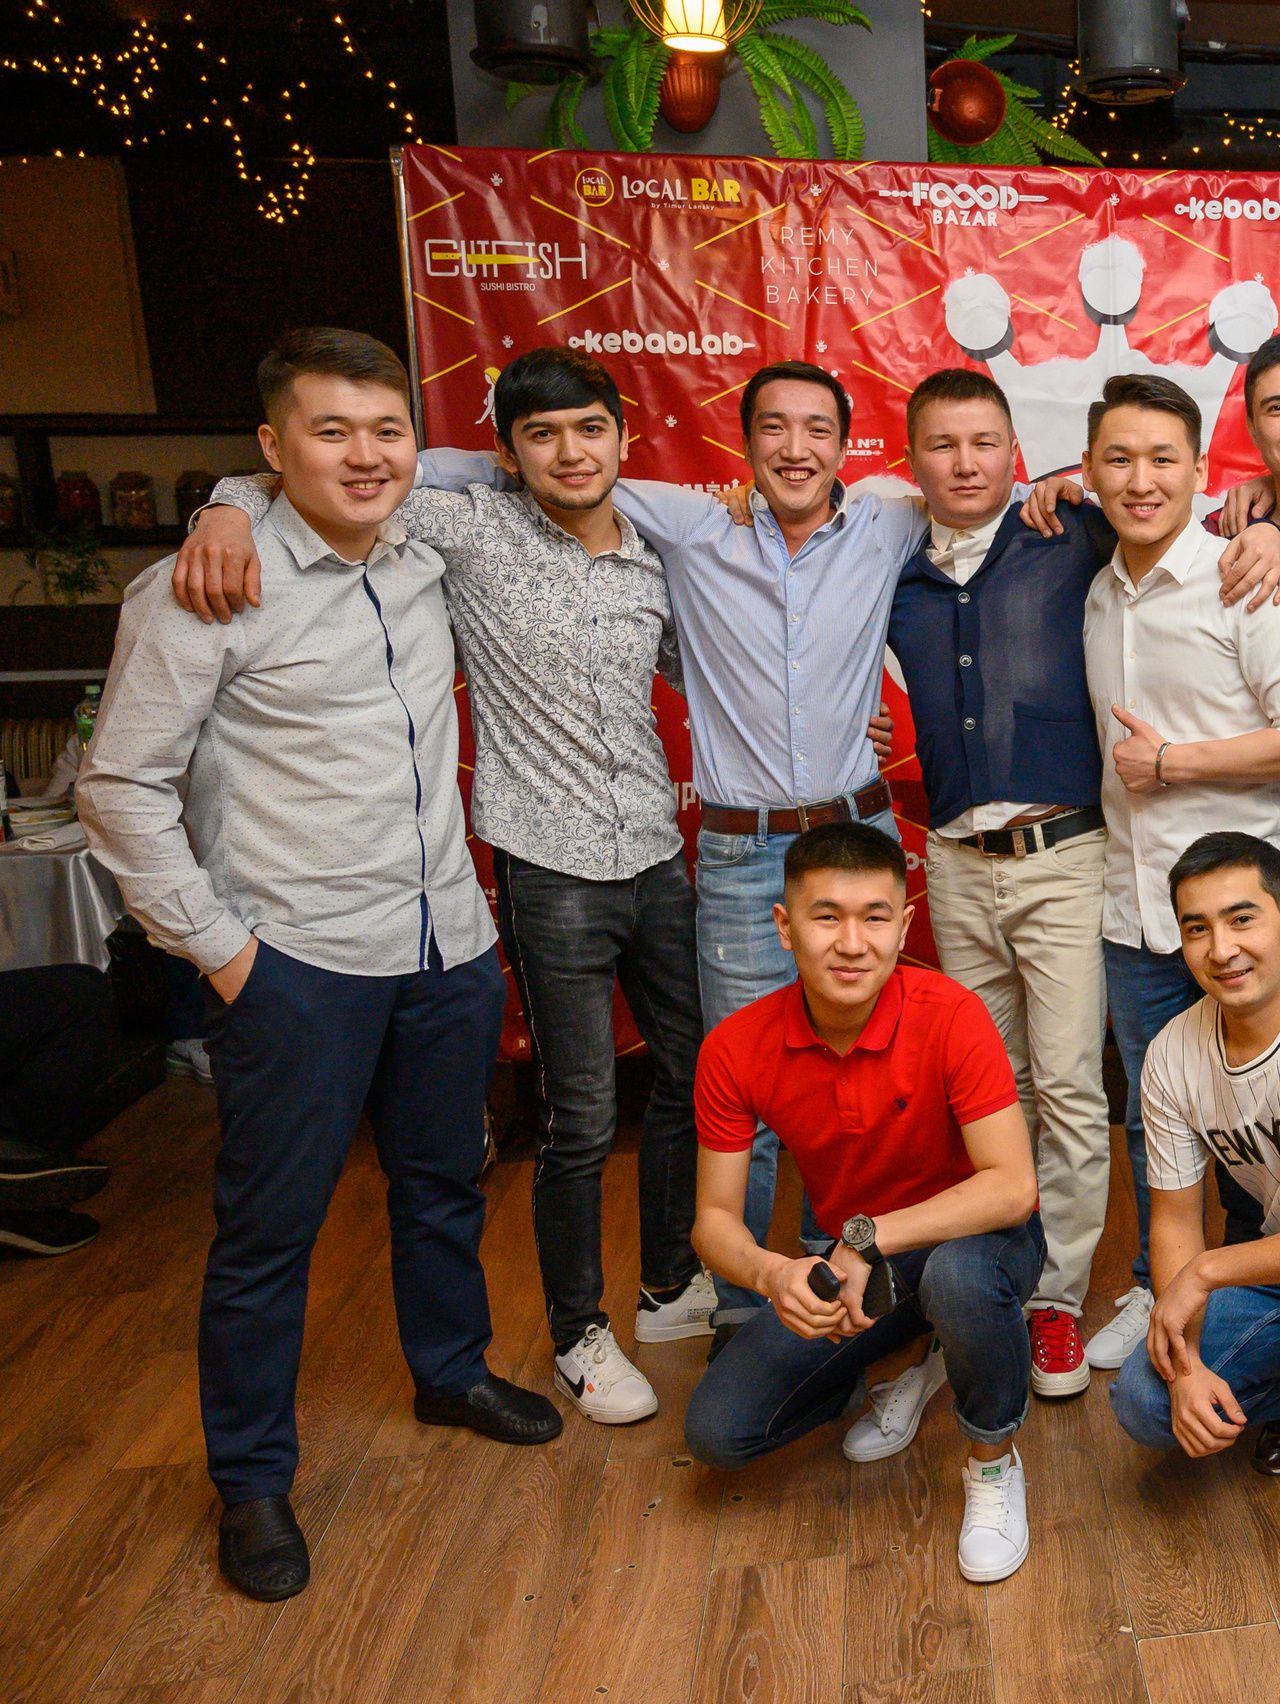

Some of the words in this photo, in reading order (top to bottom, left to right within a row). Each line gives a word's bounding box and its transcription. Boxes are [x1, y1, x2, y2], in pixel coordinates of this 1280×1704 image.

[583, 185, 607, 197] BAR
[691, 178, 741, 203] BAR
[651, 202, 660, 210] by
[932, 209, 998, 227] BAZAR
[781, 226, 854, 246] REMY
[761, 256, 878, 277] KITCHEN
[480, 282, 505, 291] SUSHI
[506, 282, 536, 292] BISTRO
[766, 285, 874, 306] BAKERY
